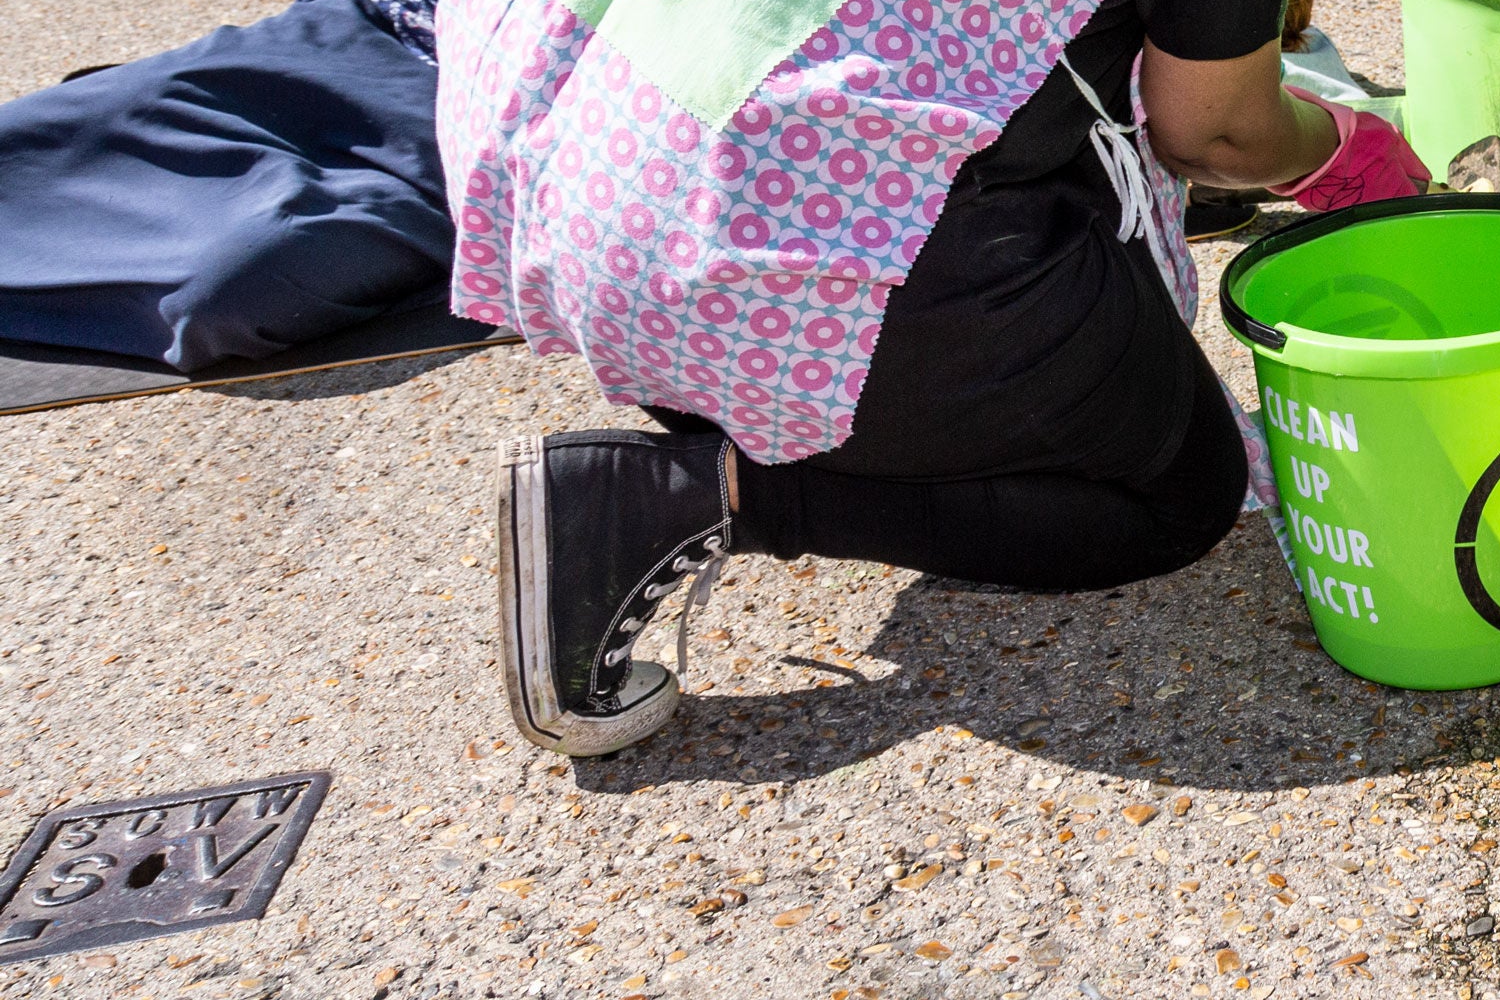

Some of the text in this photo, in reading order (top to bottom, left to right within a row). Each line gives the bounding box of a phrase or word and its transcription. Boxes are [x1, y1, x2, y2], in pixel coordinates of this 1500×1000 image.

[1264, 385, 1359, 452] CLEAN
[1290, 455, 1330, 503] UP
[1287, 501, 1374, 568] YOUR
[1307, 566, 1379, 624] ACT!
